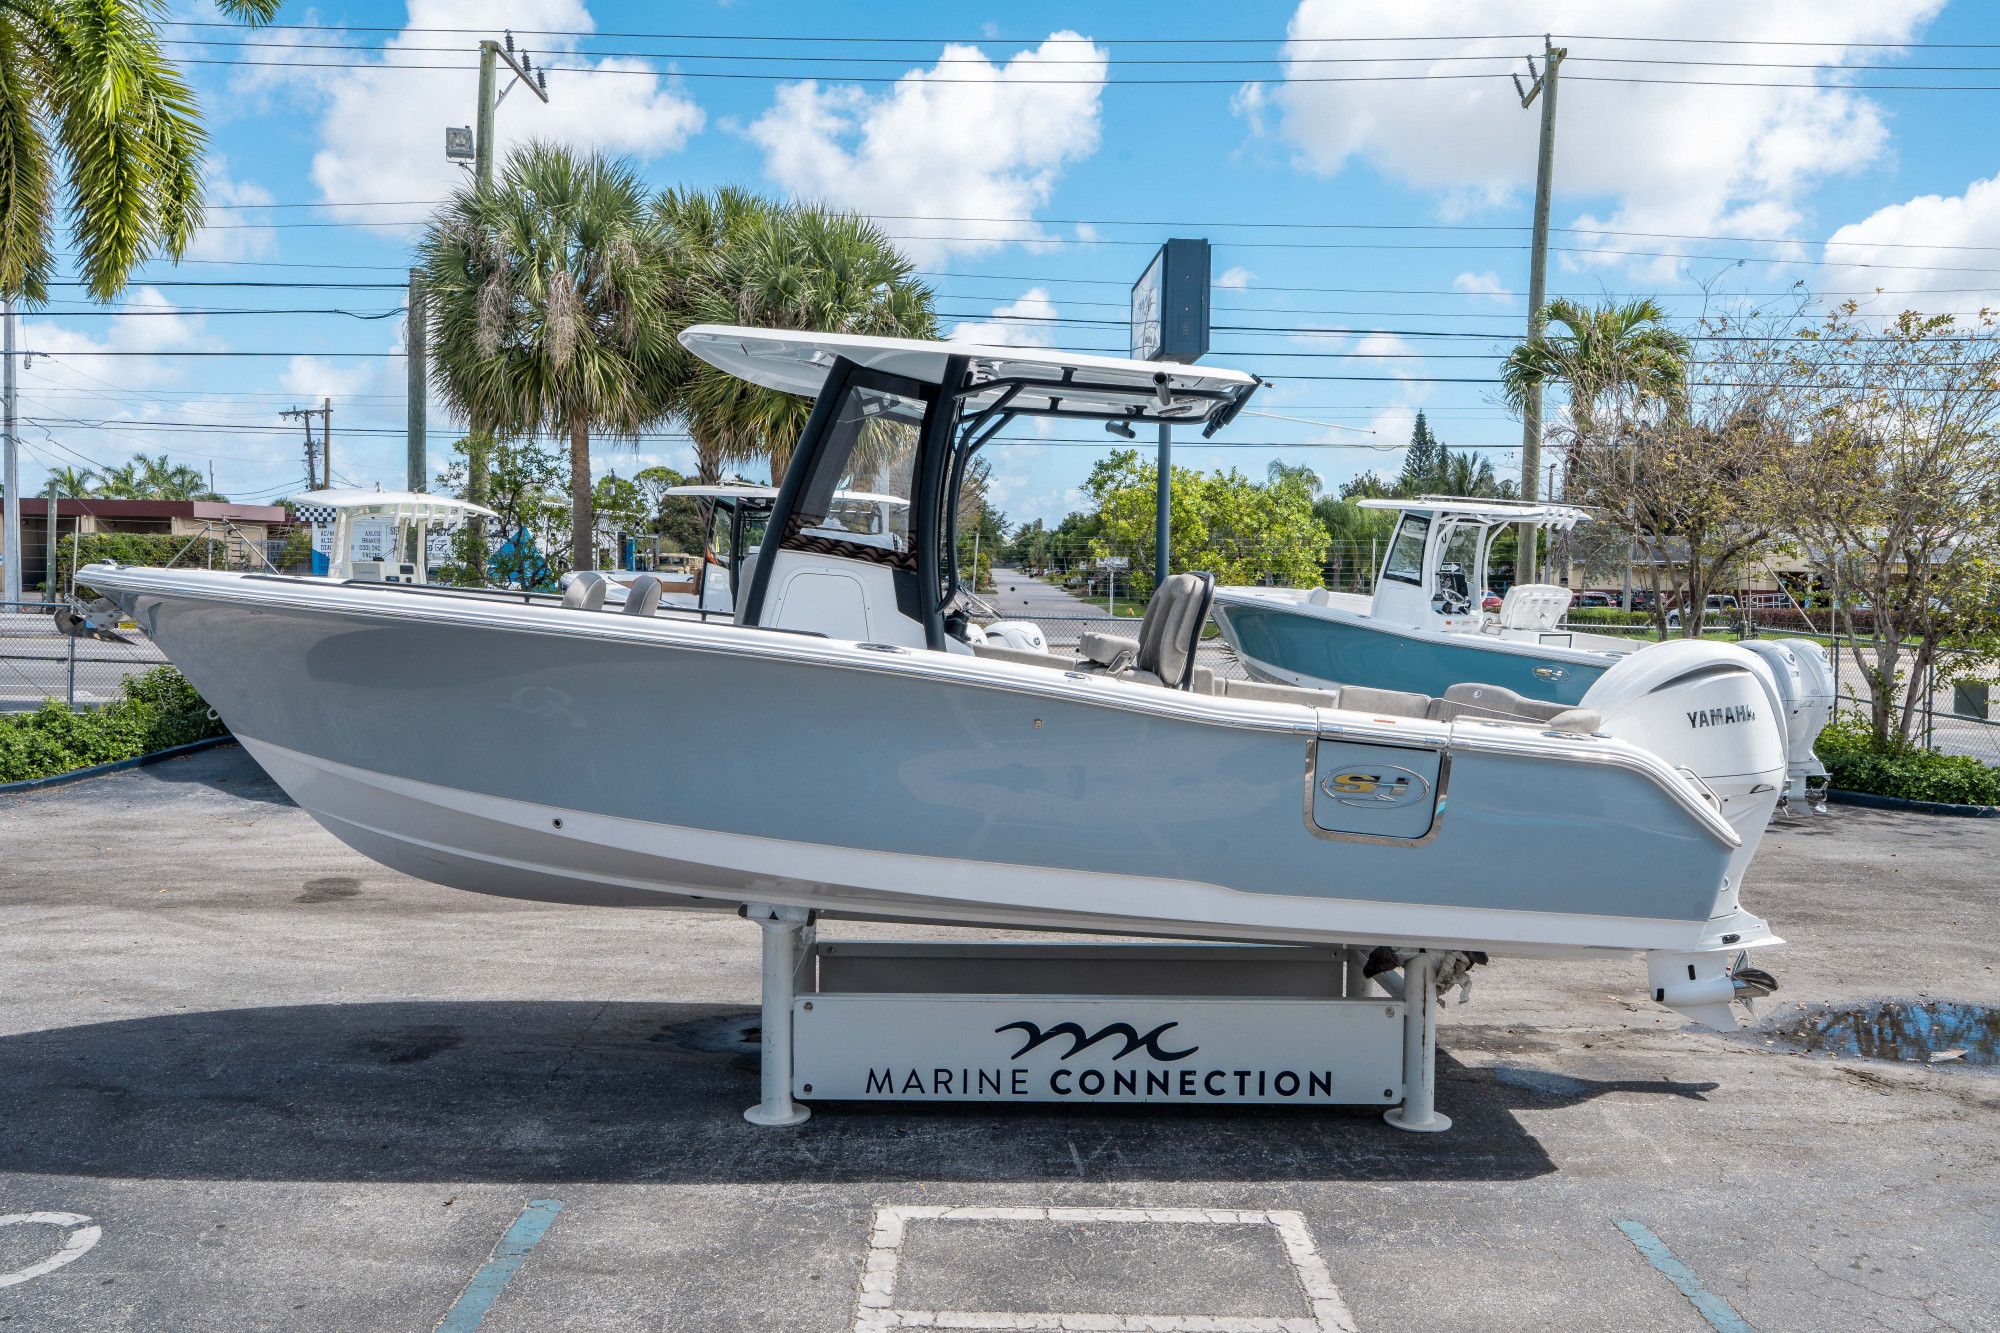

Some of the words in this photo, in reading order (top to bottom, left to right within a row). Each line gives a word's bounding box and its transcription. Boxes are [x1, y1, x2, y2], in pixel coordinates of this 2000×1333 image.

[1686, 704, 1756, 729] YAMAHA
[865, 1067, 1029, 1095] MARINE
[1049, 1069, 1332, 1097] CONNECTION
